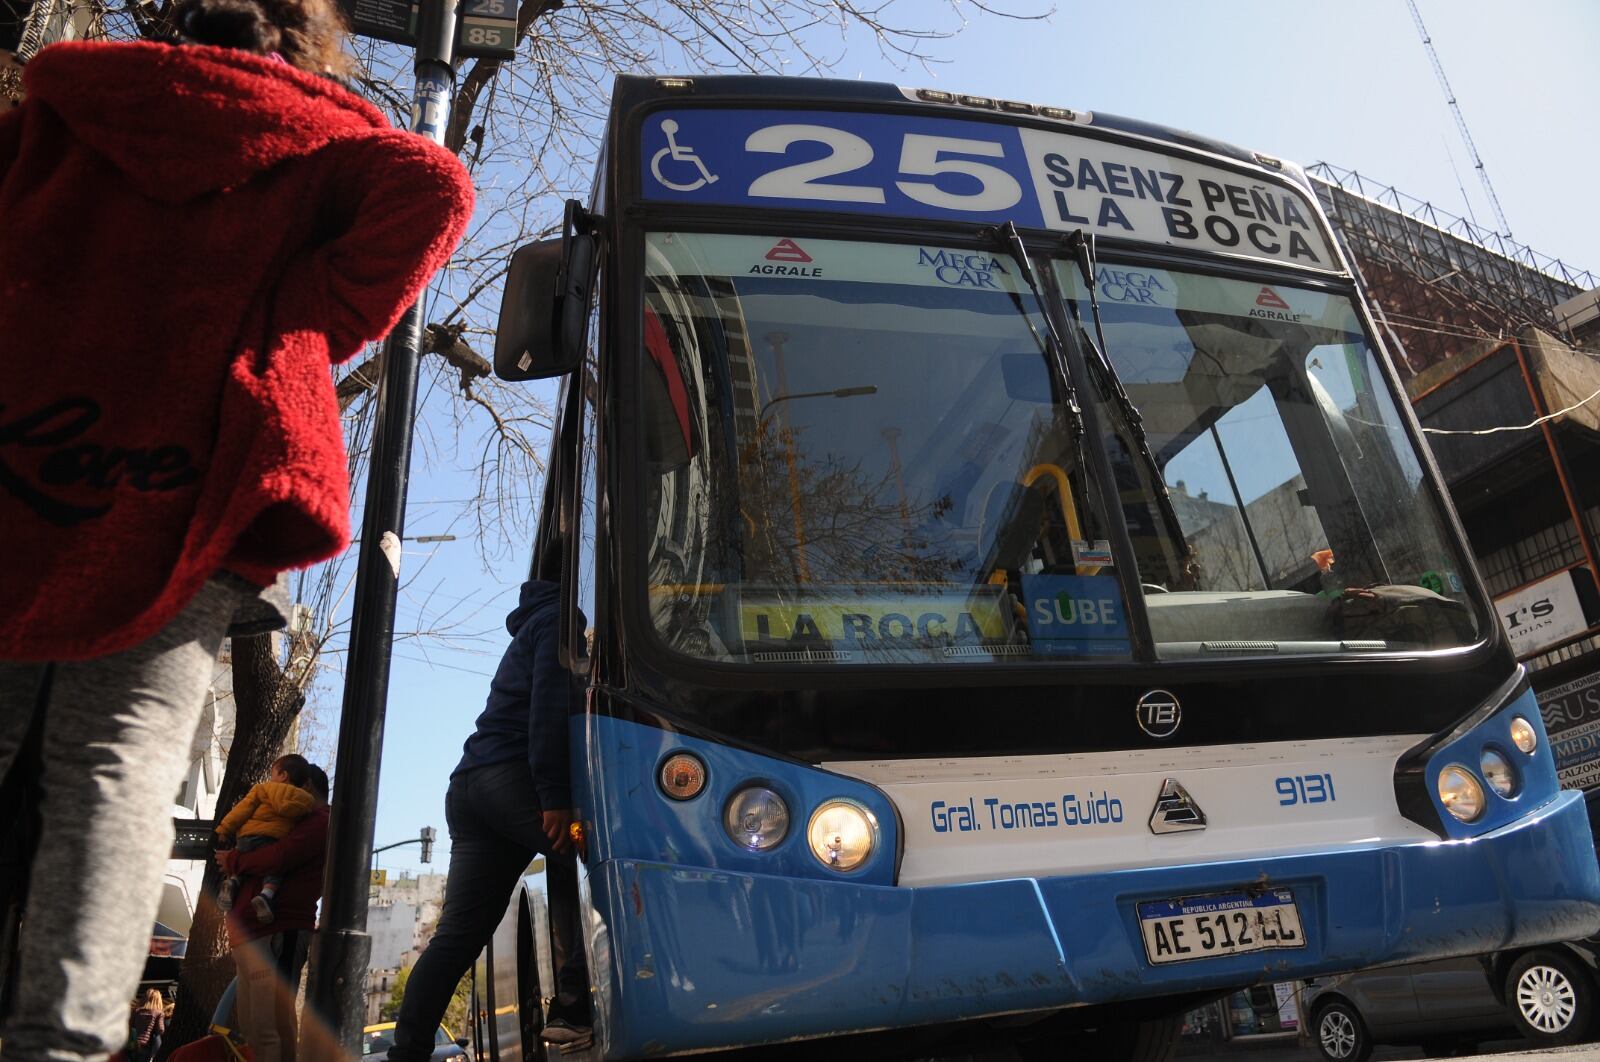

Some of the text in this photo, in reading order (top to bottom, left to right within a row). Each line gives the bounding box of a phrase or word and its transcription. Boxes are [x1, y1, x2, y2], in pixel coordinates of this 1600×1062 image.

[472, 0, 505, 14] 25
[468, 28, 501, 46] 85
[744, 123, 1023, 213] 25
[1042, 152, 1311, 231] SAENZ PEÑA
[1053, 190, 1321, 263] LA BOCA
[749, 264, 823, 278] AGRALE
[918, 247, 1011, 275] MEGA
[935, 265, 1001, 289] CAR
[1095, 266, 1169, 292] MEGA
[1101, 282, 1162, 305] CAR
[1248, 308, 1301, 323] AGRALE
[1034, 598, 1118, 625] SUBE
[756, 612, 983, 643] LA BOCA
[1275, 774, 1336, 806] 9131
[931, 791, 1123, 833] Gral. Tomas Guido
[1182, 899, 1254, 914] REPUBLICA ARGENTINA
[1154, 919, 1191, 956] AE
[1196, 912, 1253, 950] 512
